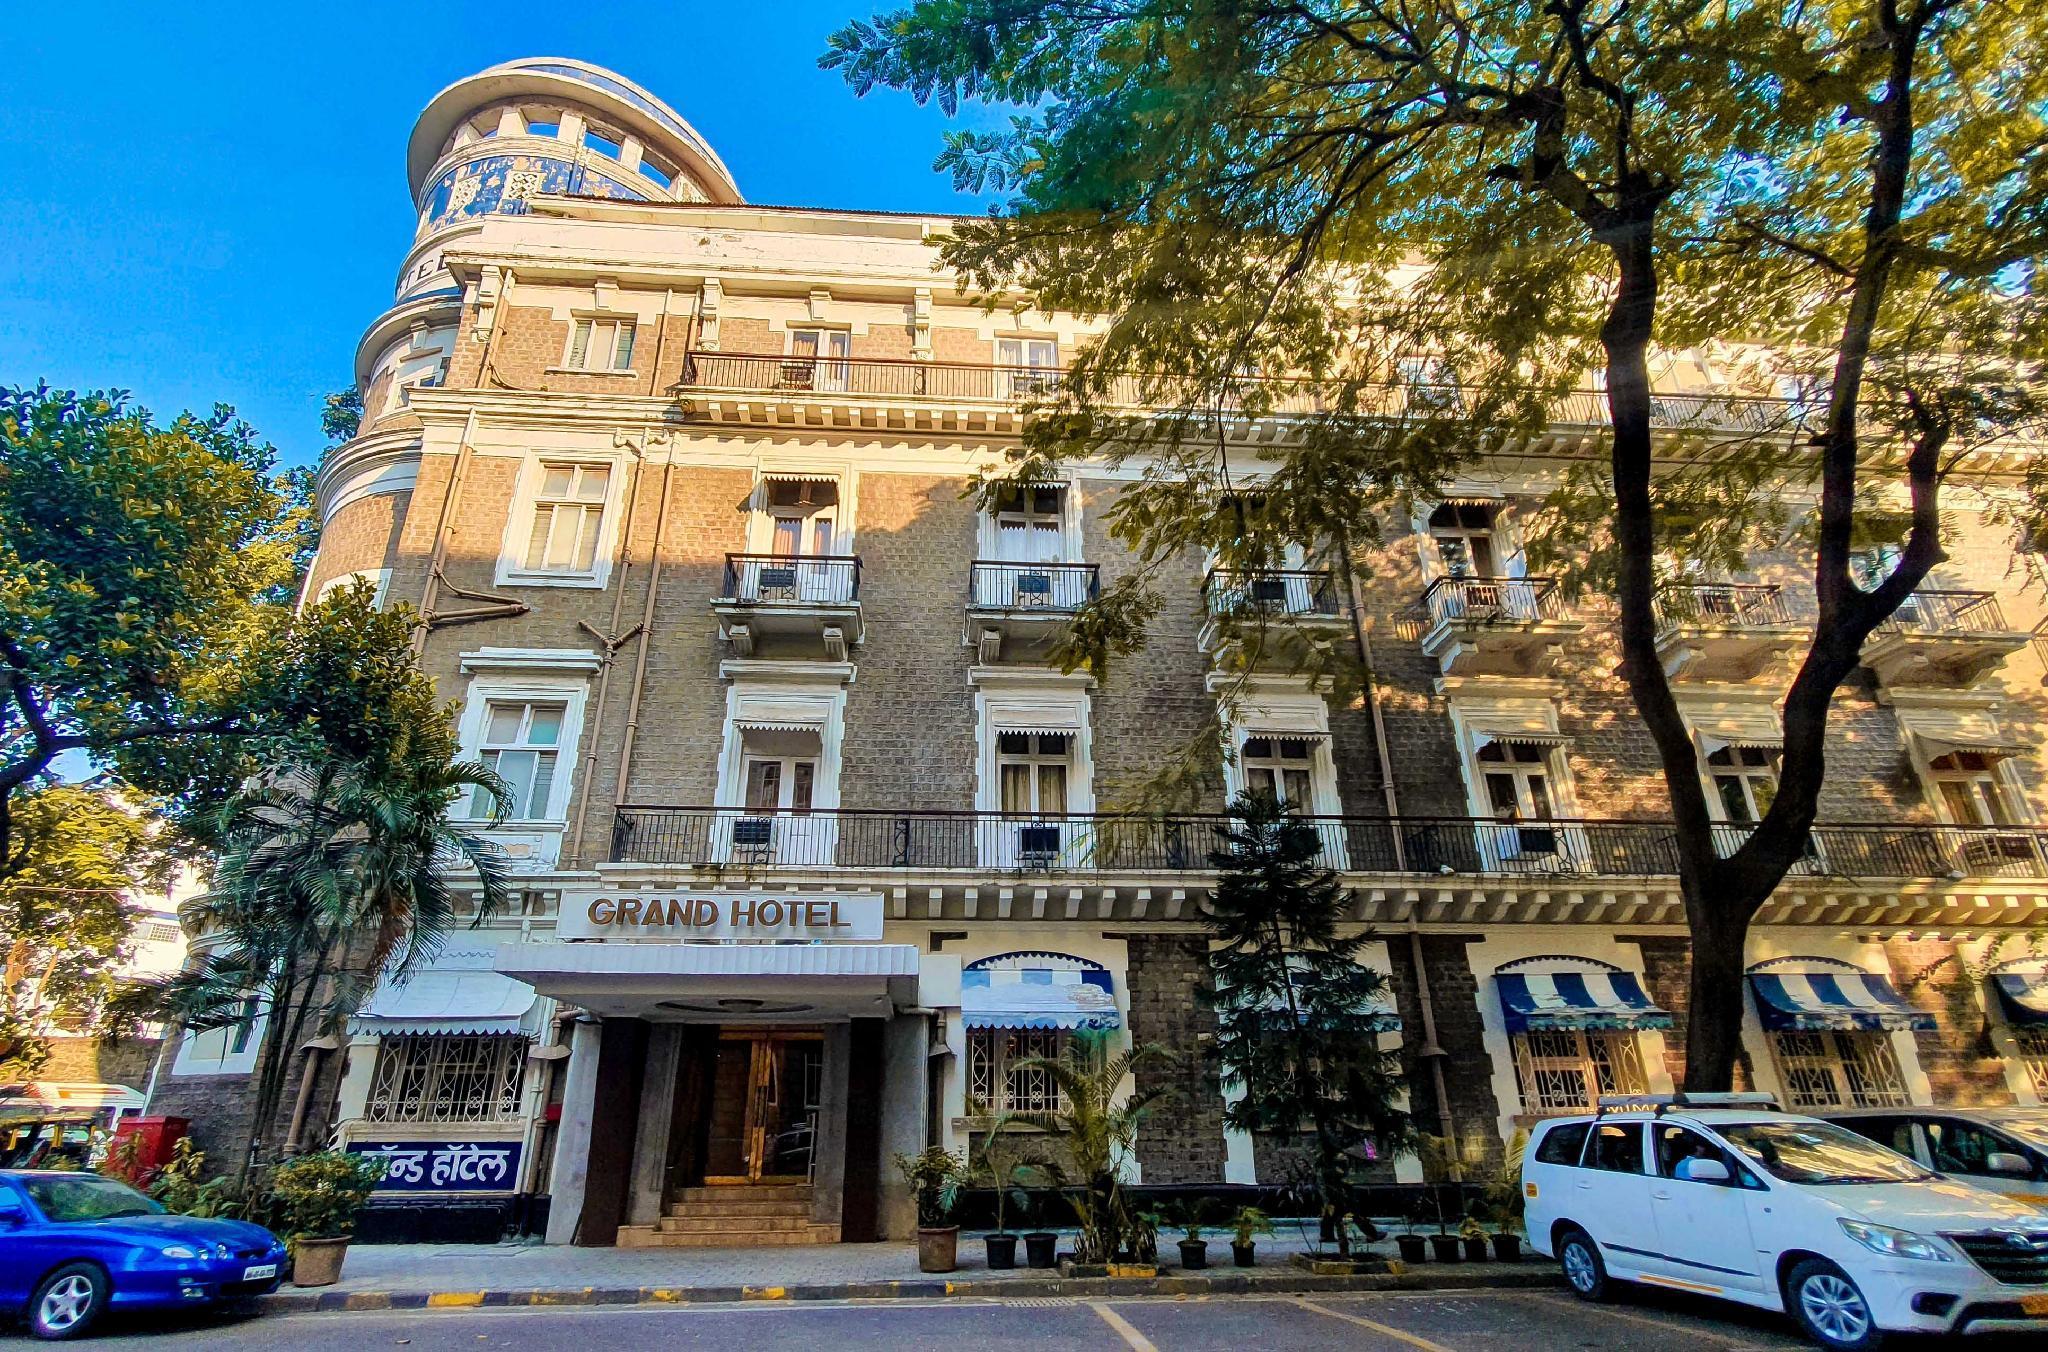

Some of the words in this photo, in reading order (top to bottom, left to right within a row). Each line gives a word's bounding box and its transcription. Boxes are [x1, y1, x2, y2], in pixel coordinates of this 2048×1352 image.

[399, 254, 448, 292] TEL
[587, 898, 720, 927] GRAND
[730, 900, 852, 928] HOTEL
[431, 1143, 511, 1186] हॉटेल
